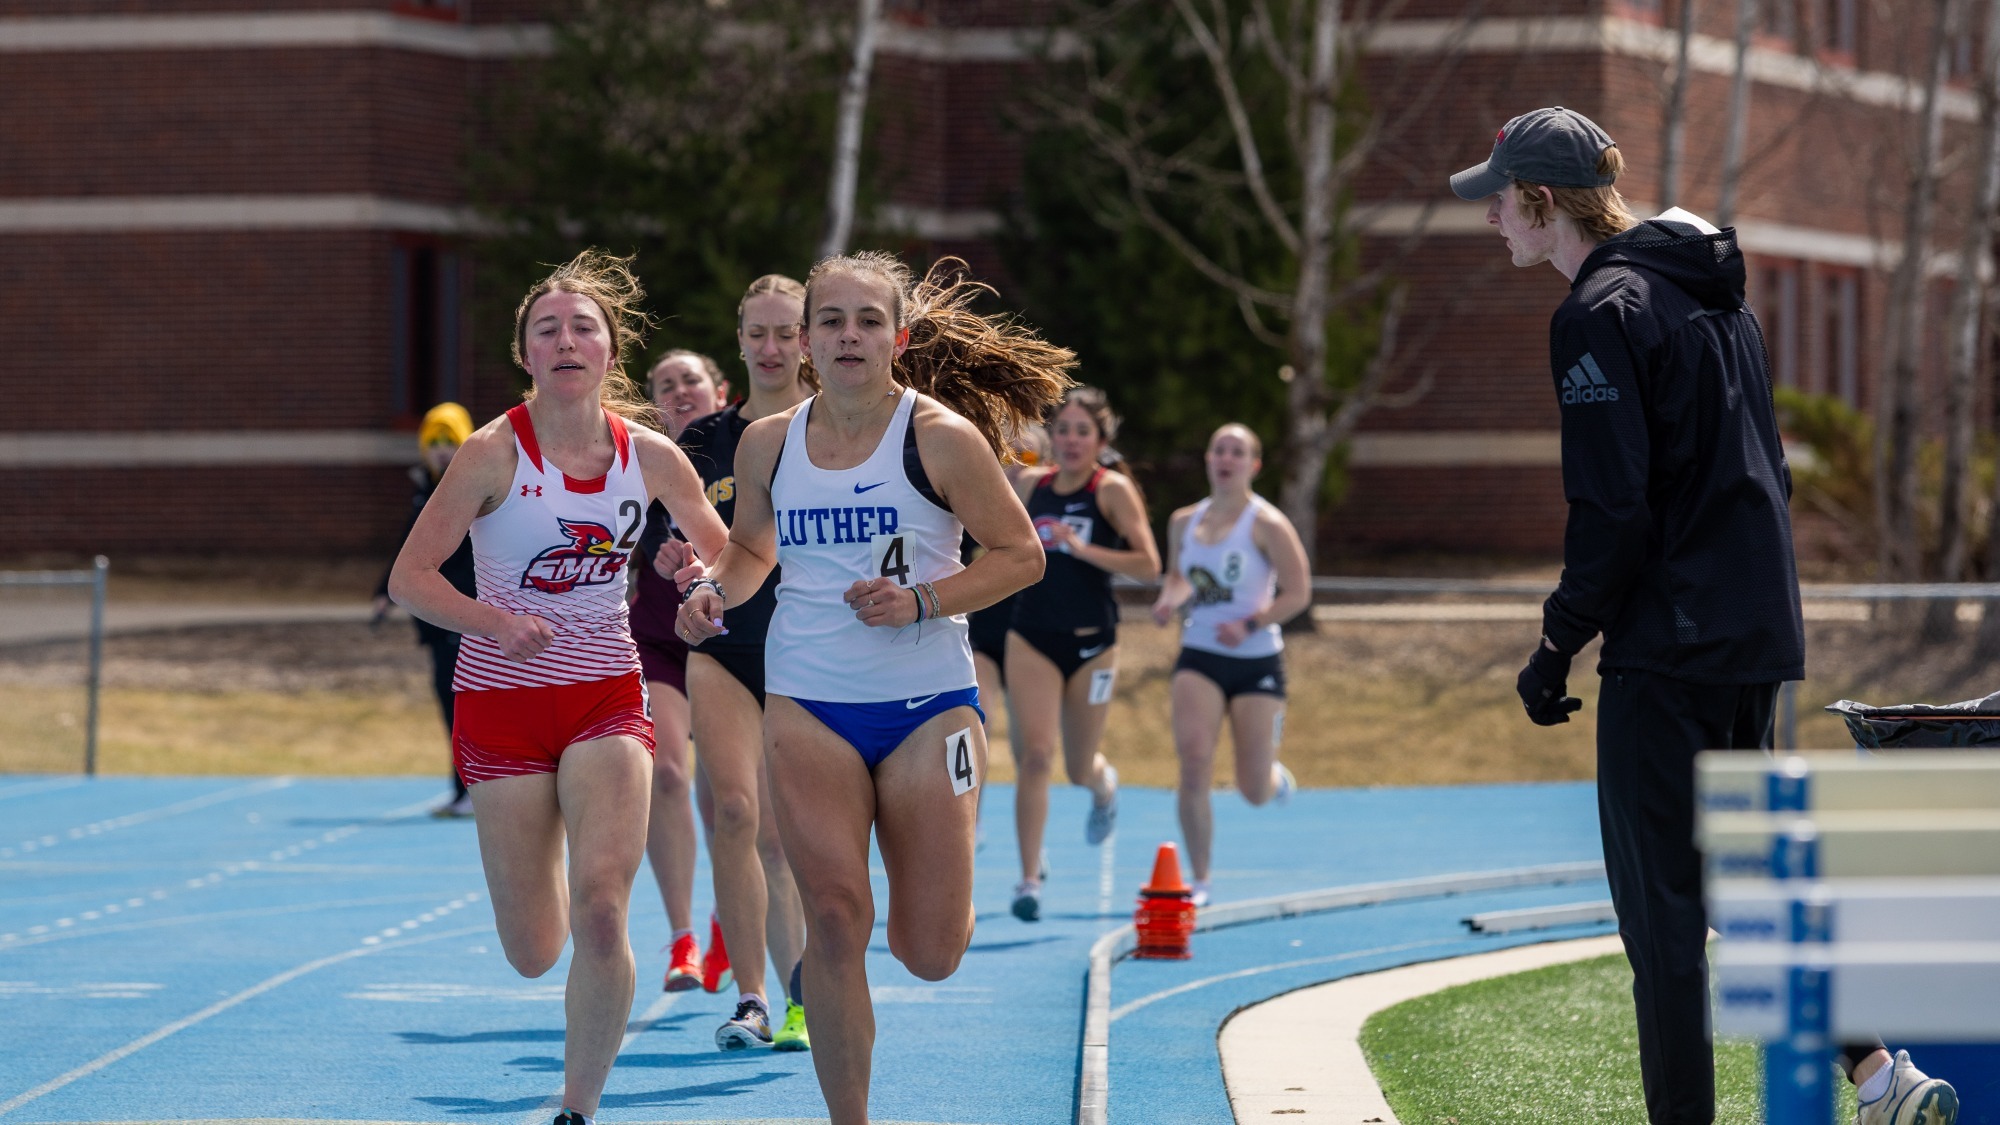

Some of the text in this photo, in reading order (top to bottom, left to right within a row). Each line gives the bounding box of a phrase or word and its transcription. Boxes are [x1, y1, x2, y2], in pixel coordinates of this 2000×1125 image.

[1562, 384, 1620, 405] didas
[616, 499, 642, 549] 2
[776, 507, 899, 546] LUTHER
[880, 536, 910, 586] 4
[1096, 673, 1112, 701] 7
[955, 734, 972, 787] 4
